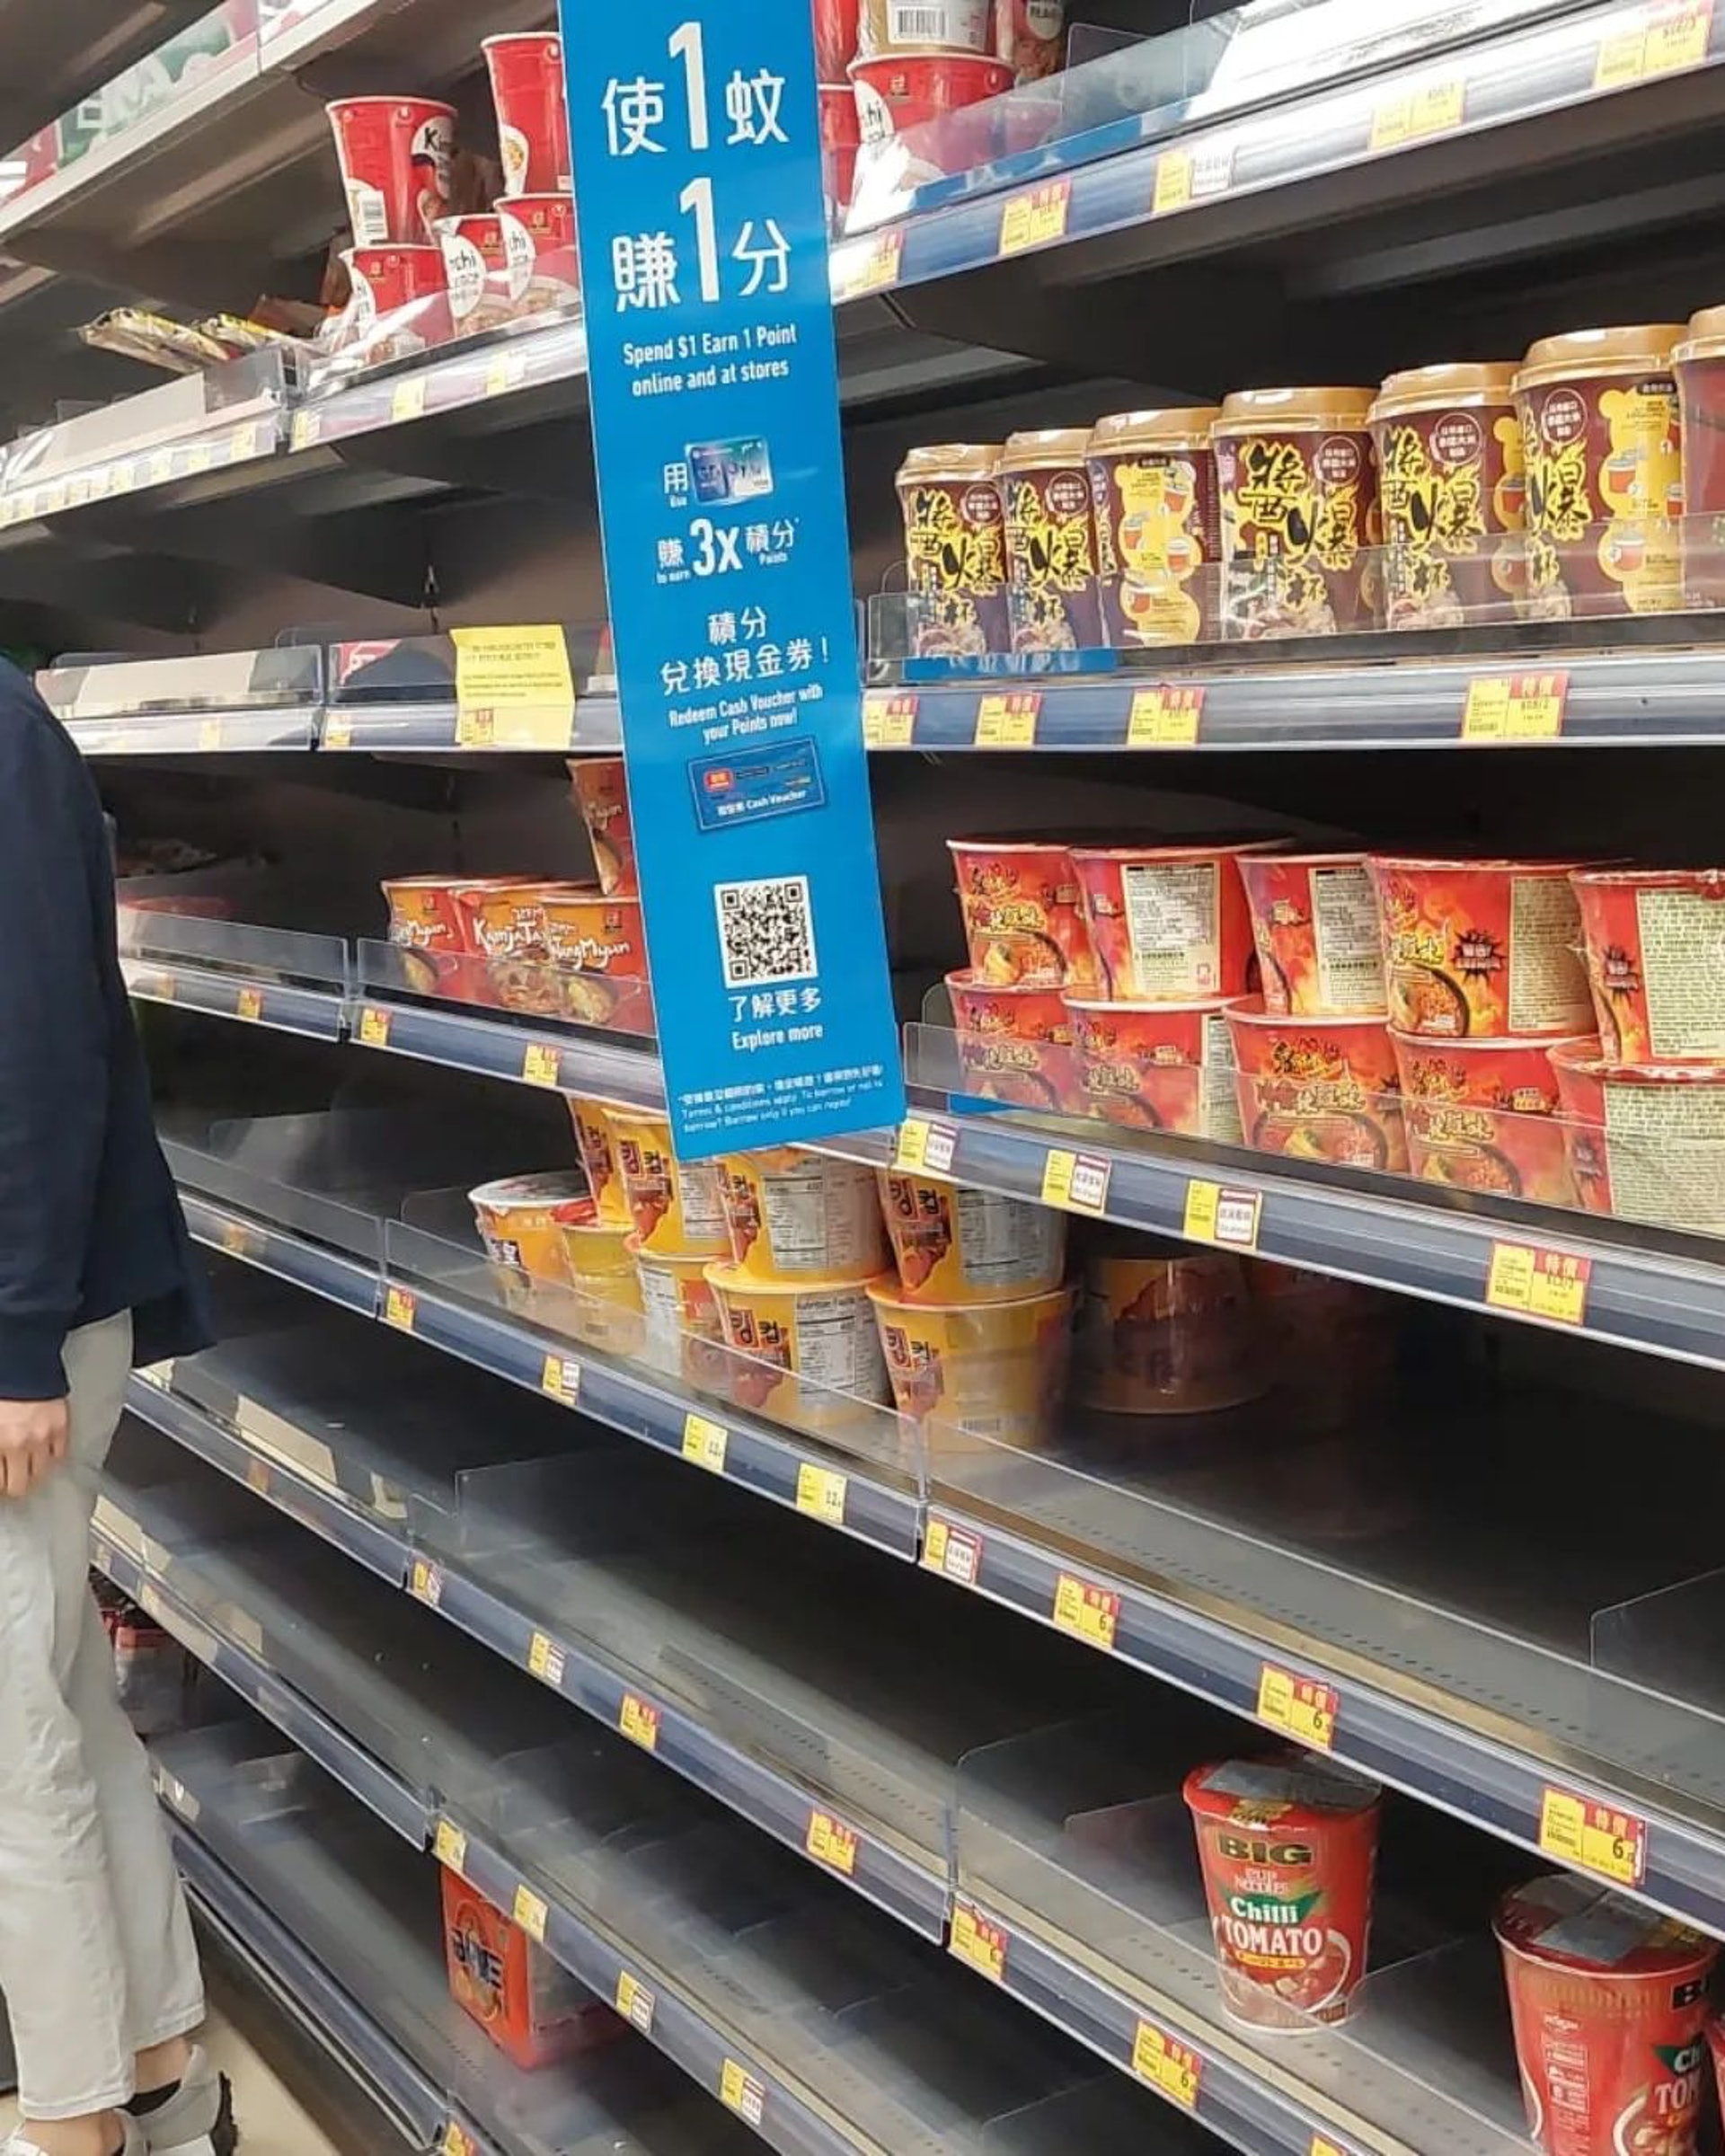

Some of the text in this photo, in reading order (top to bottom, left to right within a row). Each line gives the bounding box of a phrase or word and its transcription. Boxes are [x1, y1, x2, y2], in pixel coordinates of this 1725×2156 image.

[602, 22, 790, 155] 使1蚊
[612, 177, 791, 312] 賺1分
[624, 323, 797, 370] Spend $1 Earn 1 Point
[632, 359, 789, 396] online and at stores
[664, 463, 687, 493] 用
[707, 605, 767, 646] 積分
[668, 683, 824, 728] Redeem Cash Voucher with
[703, 706, 798, 746] your Points now!
[746, 795, 769, 809] Cash
[728, 987, 822, 1024] 了解更多
[731, 1022, 824, 1053] Explore more
[1218, 1832, 1313, 1866] BIG
[1230, 1896, 1299, 1924] Chilli
[1221, 1913, 1322, 1956] TOMATO
